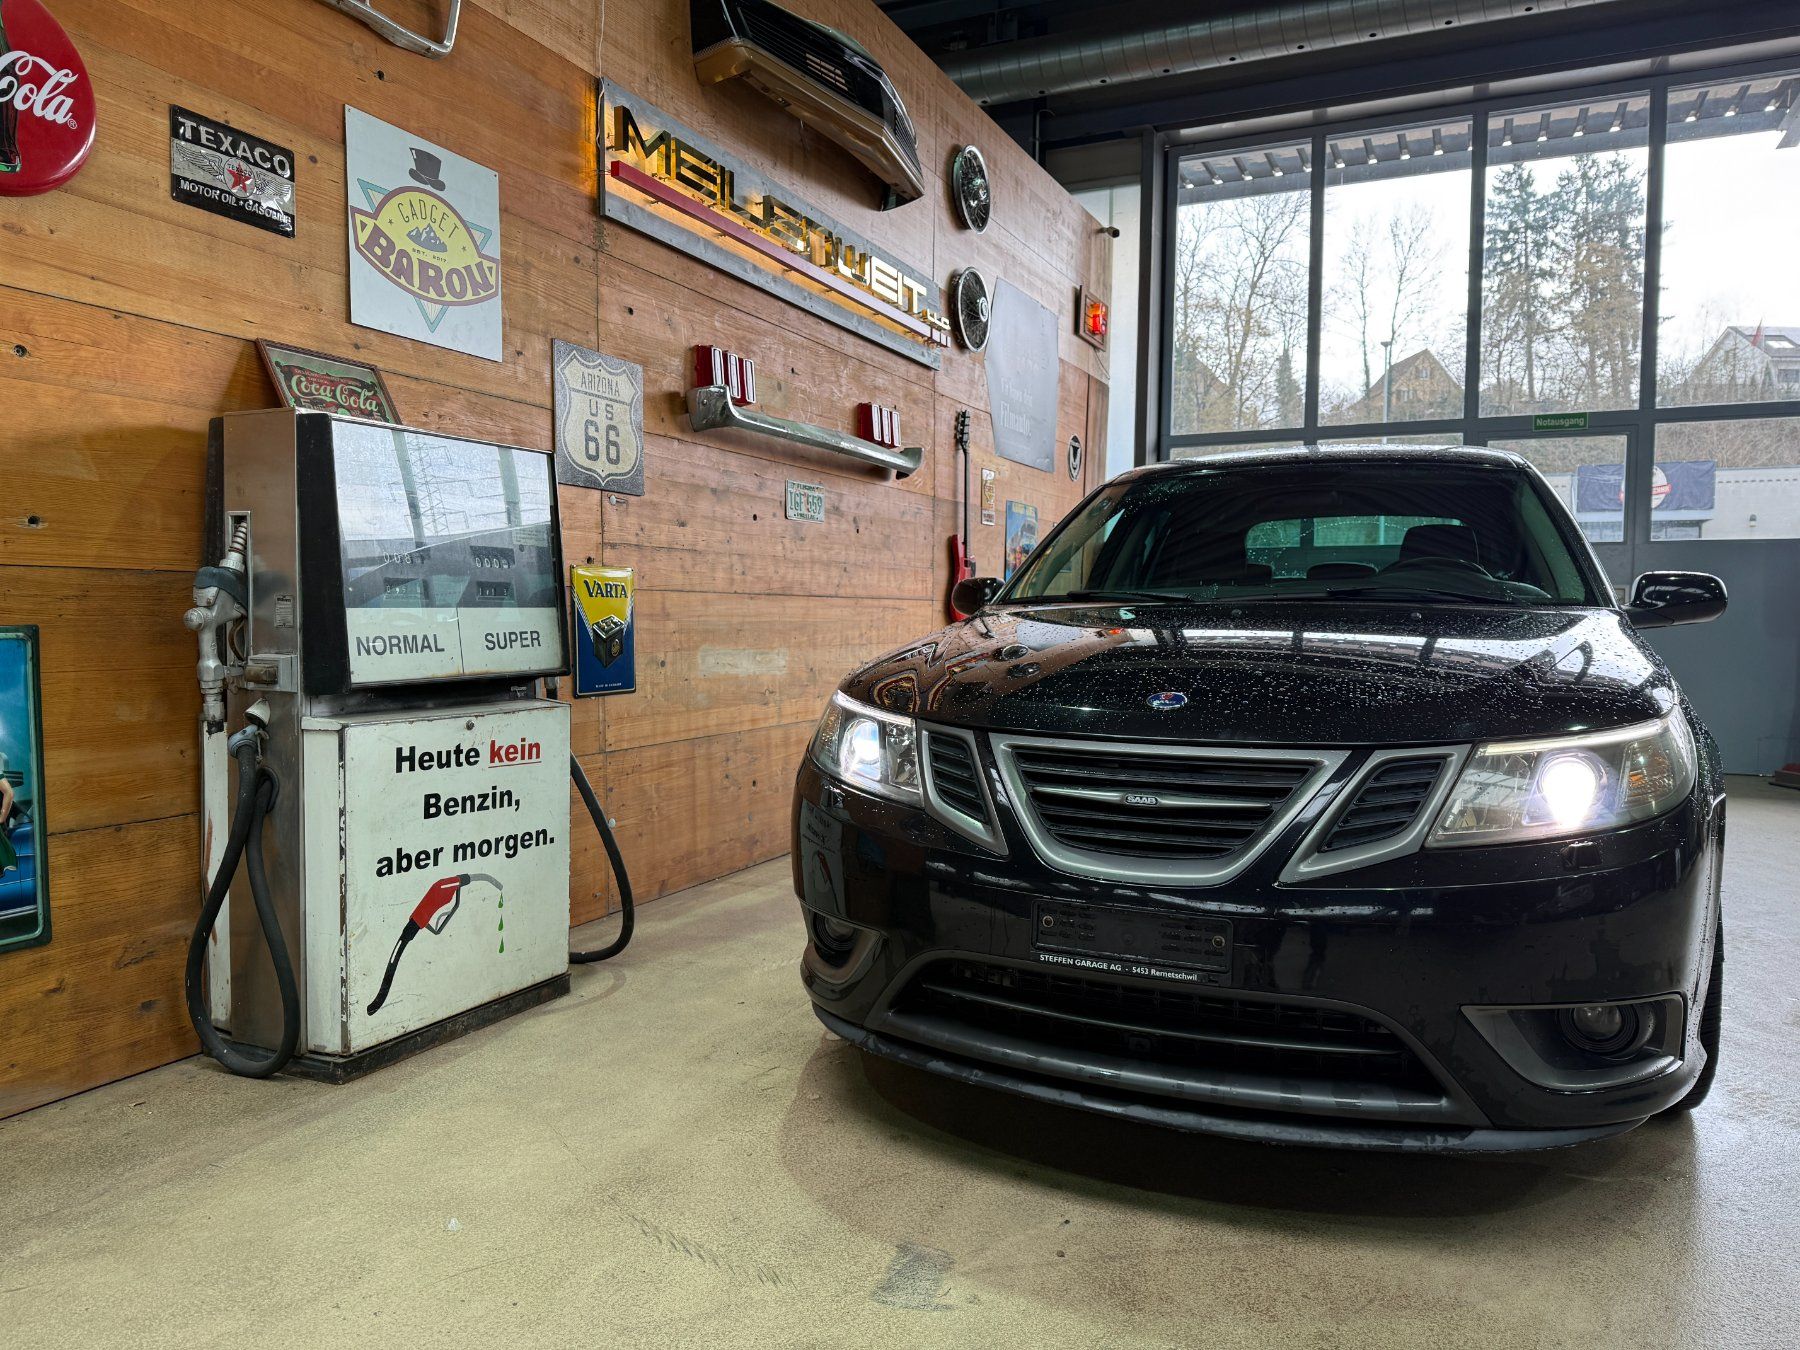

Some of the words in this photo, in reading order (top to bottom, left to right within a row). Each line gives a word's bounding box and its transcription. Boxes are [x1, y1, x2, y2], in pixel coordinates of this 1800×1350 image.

[178, 116, 291, 178] TEXACO
[180, 179, 220, 200] MOTOR
[221, 193, 237, 206] OIL
[397, 199, 460, 239] GADGET
[361, 223, 494, 300] BARON
[581, 371, 620, 397] ARIZONA
[1536, 417, 1585, 427] Notausgang
[584, 419, 621, 466] 66
[584, 579, 628, 598] VARTA
[355, 634, 445, 656] NORMAL
[484, 631, 541, 650] SUPER
[395, 743, 480, 773] Heute
[489, 737, 541, 764] kein
[423, 785, 521, 820] Benzin,
[1126, 796, 1157, 805] SAAB
[376, 847, 444, 878] aber
[452, 828, 555, 863] morgen.
[1039, 954, 1074, 966] STEFFEN
[1075, 959, 1109, 970] GARAGE
[1110, 963, 1122, 972] AG
[1132, 966, 1149, 975] 5453
[1150, 969, 1198, 981] Remetschwil
